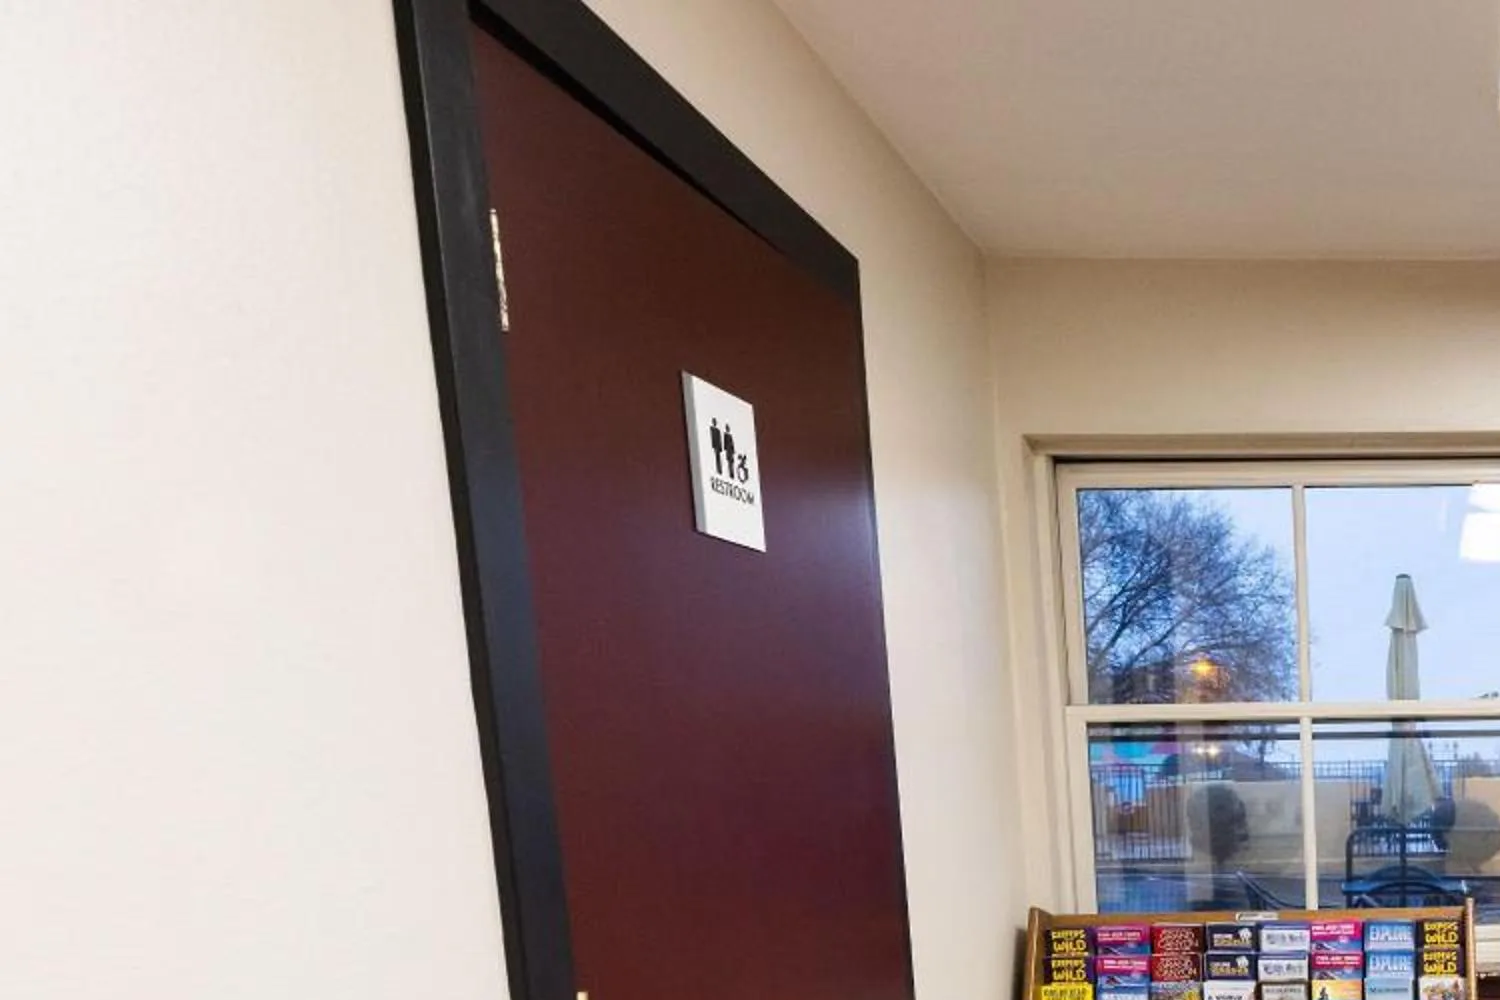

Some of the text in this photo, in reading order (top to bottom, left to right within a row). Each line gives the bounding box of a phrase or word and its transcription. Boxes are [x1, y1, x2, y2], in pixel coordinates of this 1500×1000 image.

[710, 475, 755, 505] RESTROOM
[1425, 932, 1460, 945] WILD
[1053, 940, 1086, 952] WILD
[1424, 961, 1458, 973] WILD
[1053, 968, 1086, 980] WILD
